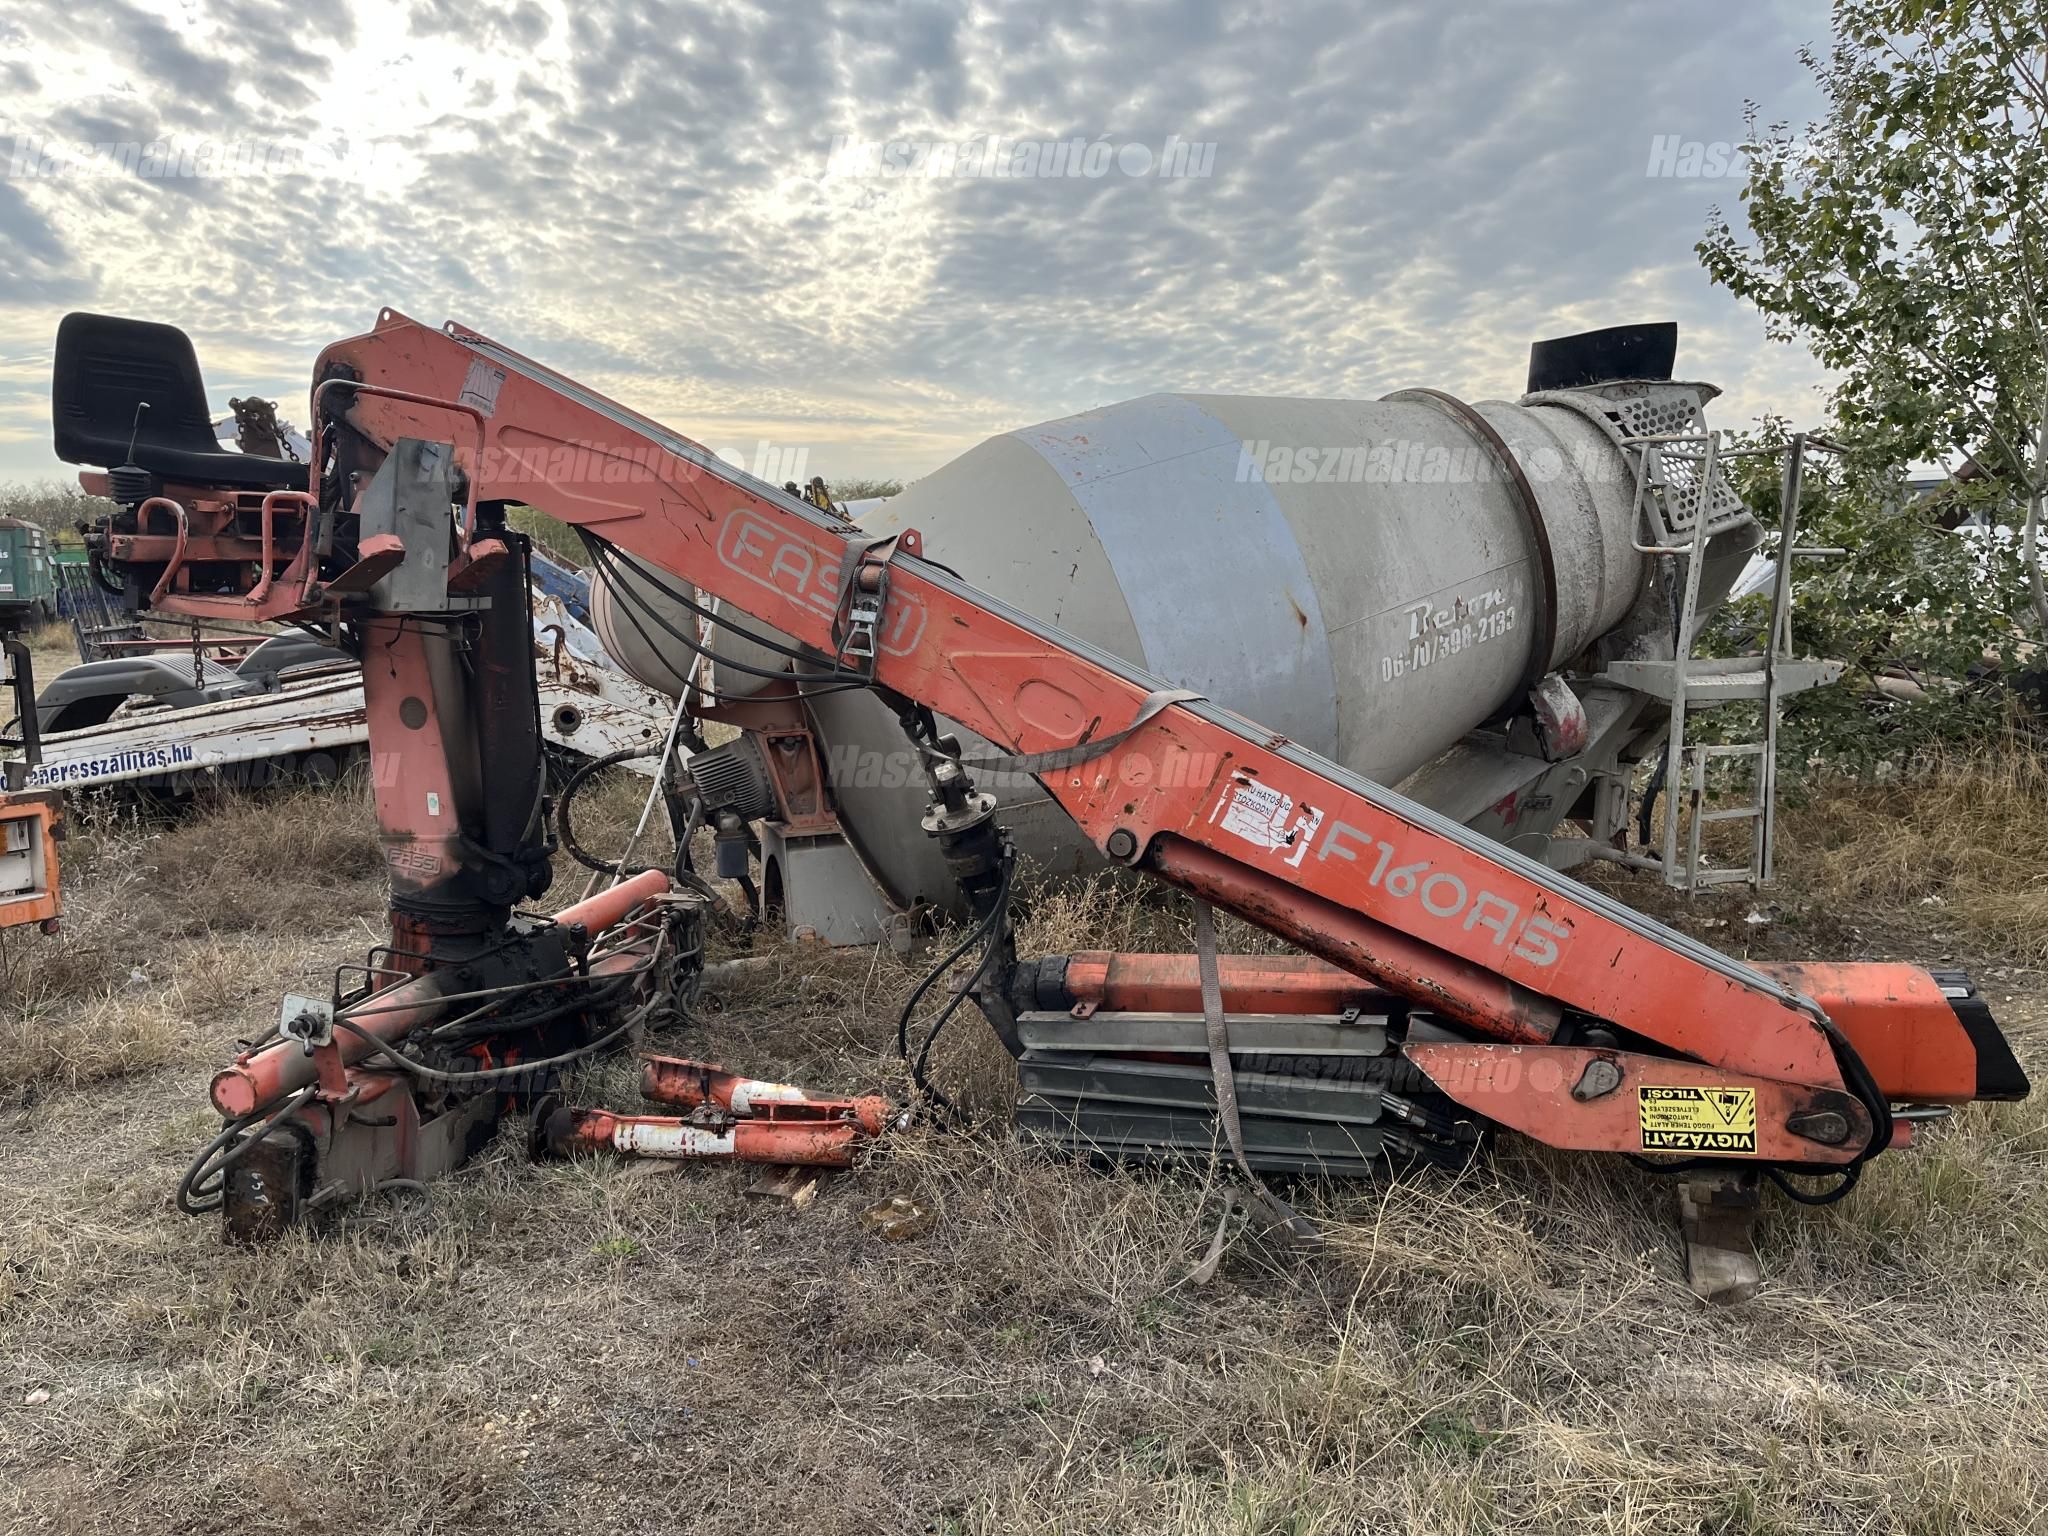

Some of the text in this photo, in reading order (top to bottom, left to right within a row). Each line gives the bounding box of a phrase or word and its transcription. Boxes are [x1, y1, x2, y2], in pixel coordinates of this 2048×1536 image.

[732, 521, 912, 643] FASI
[390, 851, 441, 871] FASSI
[1317, 820, 1569, 966] F160AS
[1647, 1089, 1698, 1099] TILOS!
[1645, 1132, 1753, 1150] VIGYÁZAT!
